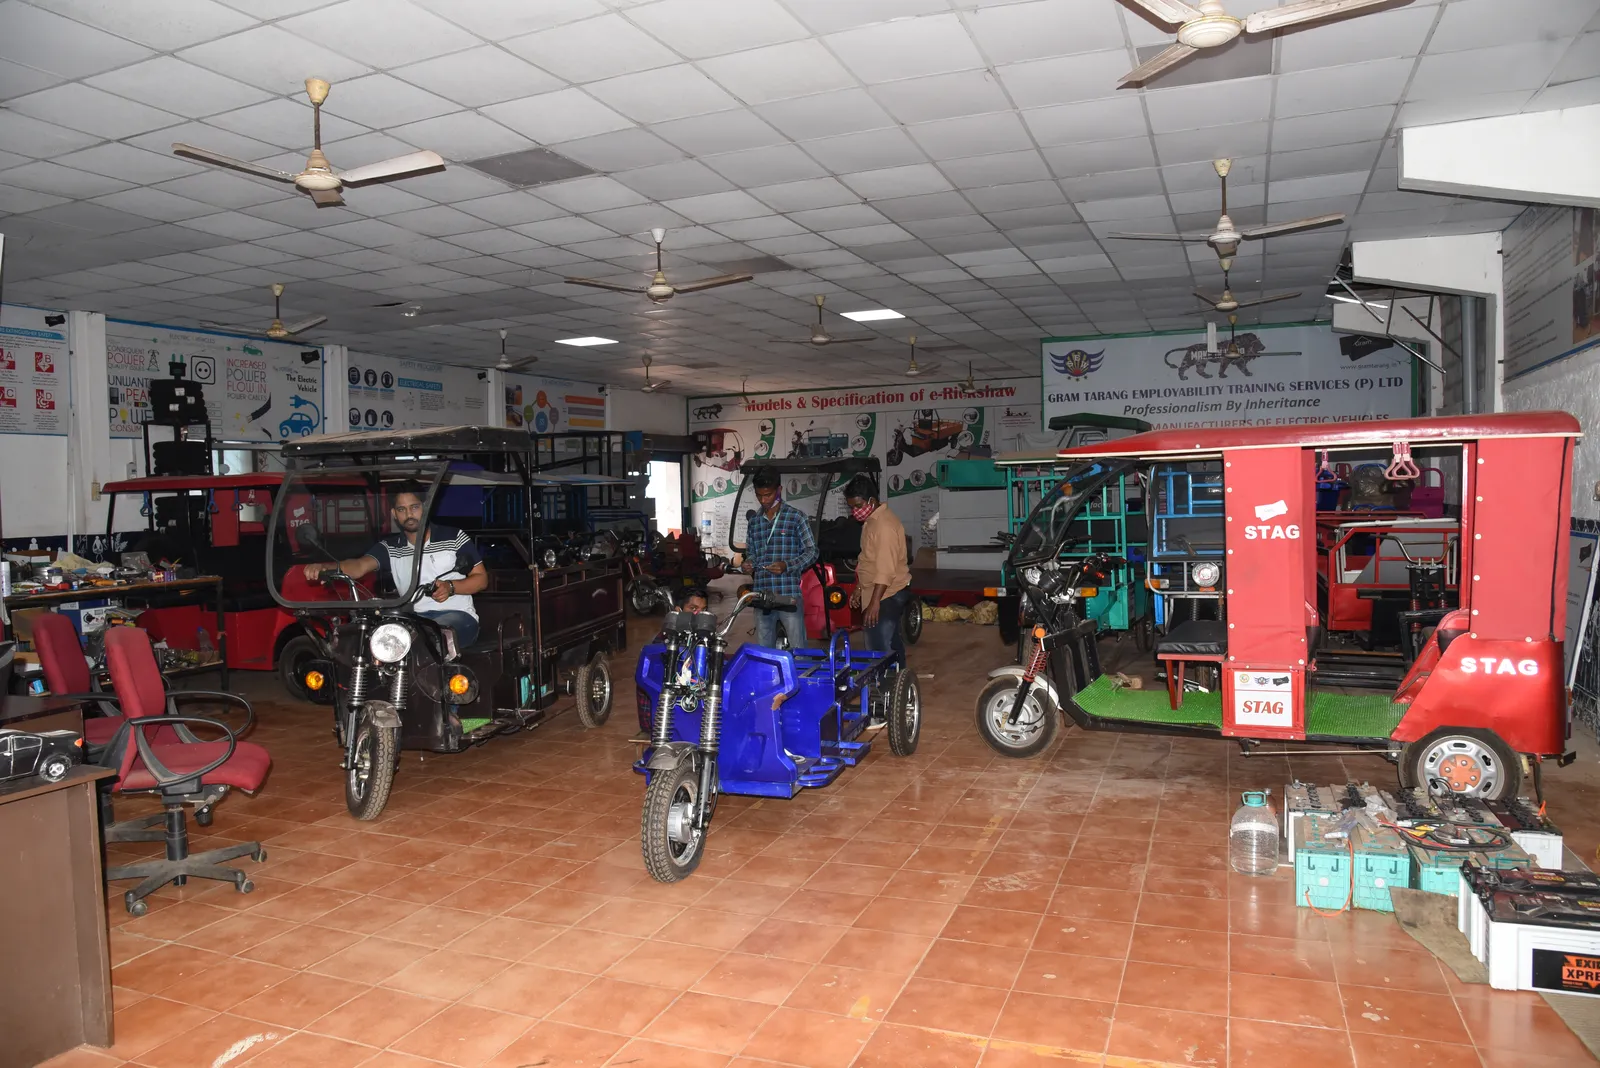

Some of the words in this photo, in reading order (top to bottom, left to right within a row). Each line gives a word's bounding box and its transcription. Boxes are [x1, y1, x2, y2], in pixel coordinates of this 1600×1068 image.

[107, 345, 145, 354] CONSEQUENT
[107, 352, 145, 366] POWER
[226, 359, 267, 370] INCREASED
[108, 375, 154, 388] UNWANT
[226, 368, 267, 383] POWER
[286, 373, 296, 382] The
[297, 375, 317, 384] Electric
[226, 381, 254, 392] FLOW
[257, 384, 267, 394] IN
[297, 384, 317, 393] Vehicle
[399, 379, 425, 388] ELECTRICAL
[425, 382, 441, 390] SAFETY
[1048, 392, 1080, 403] GRAM
[1084, 390, 1128, 401] TARANG
[1132, 385, 1224, 399] EMPLOYABILITY
[1228, 381, 1285, 395] TRAINING
[1289, 379, 1350, 392] SERVICES
[1354, 378, 1374, 391] (P)
[1379, 376, 1404, 388] LTD
[126, 388, 152, 401] PEA
[796, 396, 807, 410] &
[811, 391, 904, 411] Specification
[910, 389, 925, 402] of
[1124, 402, 1222, 416] Professionalism
[1226, 400, 1242, 413] By
[1246, 397, 1321, 410] Inheritance
[1151, 419, 1253, 431] MANUFACTURERS
[1244, 524, 1301, 540] STAG
[1460, 657, 1539, 676] STAG
[1242, 700, 1284, 715] STAG
